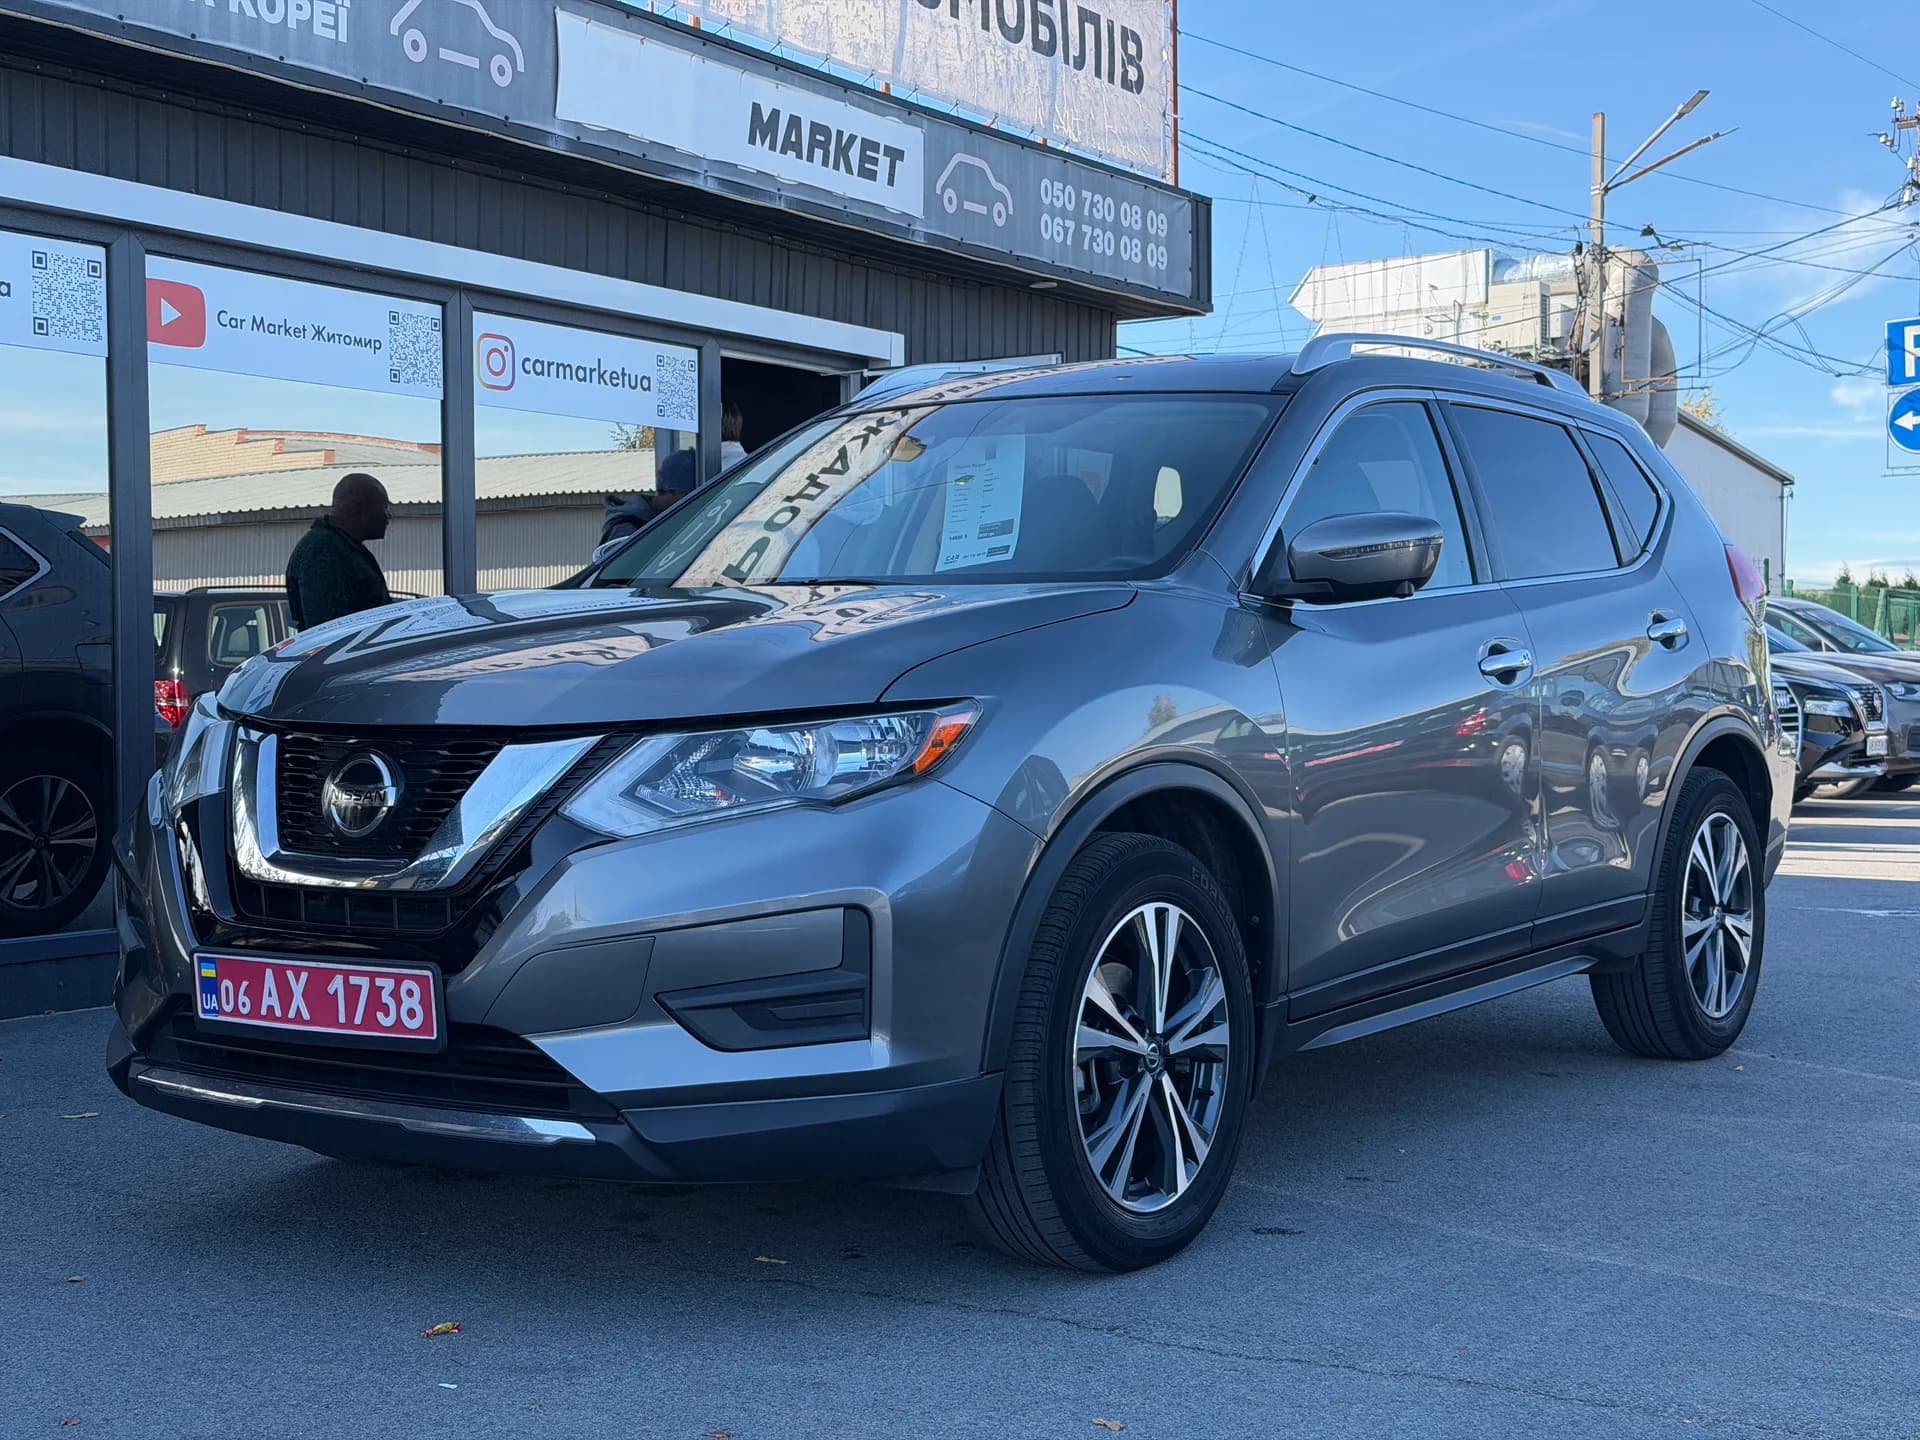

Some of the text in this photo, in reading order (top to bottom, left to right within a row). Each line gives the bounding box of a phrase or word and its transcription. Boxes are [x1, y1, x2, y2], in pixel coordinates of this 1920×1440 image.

[748, 101, 905, 187] MARKET
[1040, 178, 1168, 238] 050 730 08 09
[1040, 213, 1168, 270] 067 730 08 09
[216, 309, 382, 354] Car Market Житомир
[521, 356, 652, 392] carmarketua
[331, 788, 387, 805] NISSAN
[202, 993, 219, 1011] UA
[220, 968, 424, 1030] 06 AX 1738
